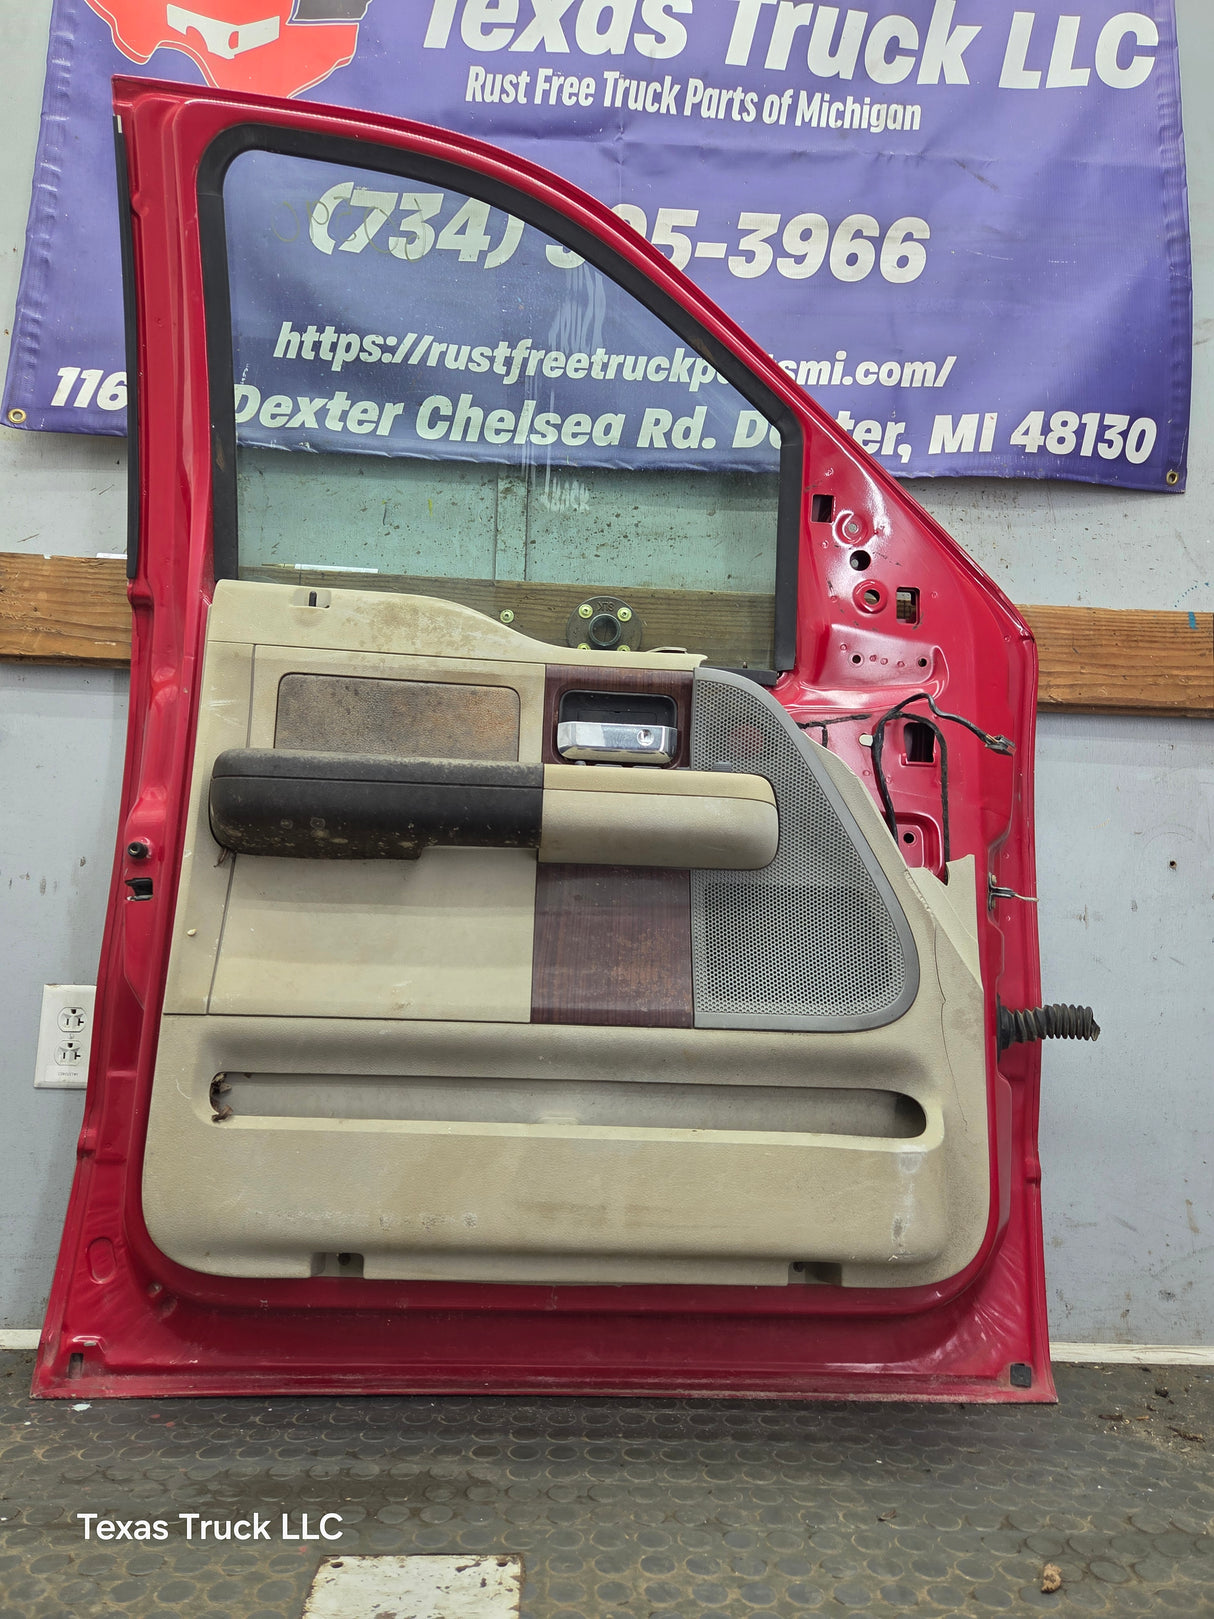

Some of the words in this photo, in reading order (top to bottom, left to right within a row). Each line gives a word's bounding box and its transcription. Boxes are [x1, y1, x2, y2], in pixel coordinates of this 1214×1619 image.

[725, 0, 982, 85] Truck
[999, 12, 1160, 89] LLC
[465, 66, 530, 105] Rust
[534, 68, 596, 107] Free
[603, 71, 681, 117] Truck
[684, 78, 758, 123] Parts
[766, 89, 794, 126] of
[795, 90, 922, 133] Michigan
[309, 181, 525, 270] (734)
[272, 321, 958, 392] https://rustfreetruckpsmi.com/
[233, 383, 405, 436] Dexter
[415, 393, 626, 447] Chelsea
[636, 405, 717, 449] Rd.
[732, 409, 911, 463] Dter,
[928, 412, 998, 455] MI
[1009, 410, 1158, 464] 48130
